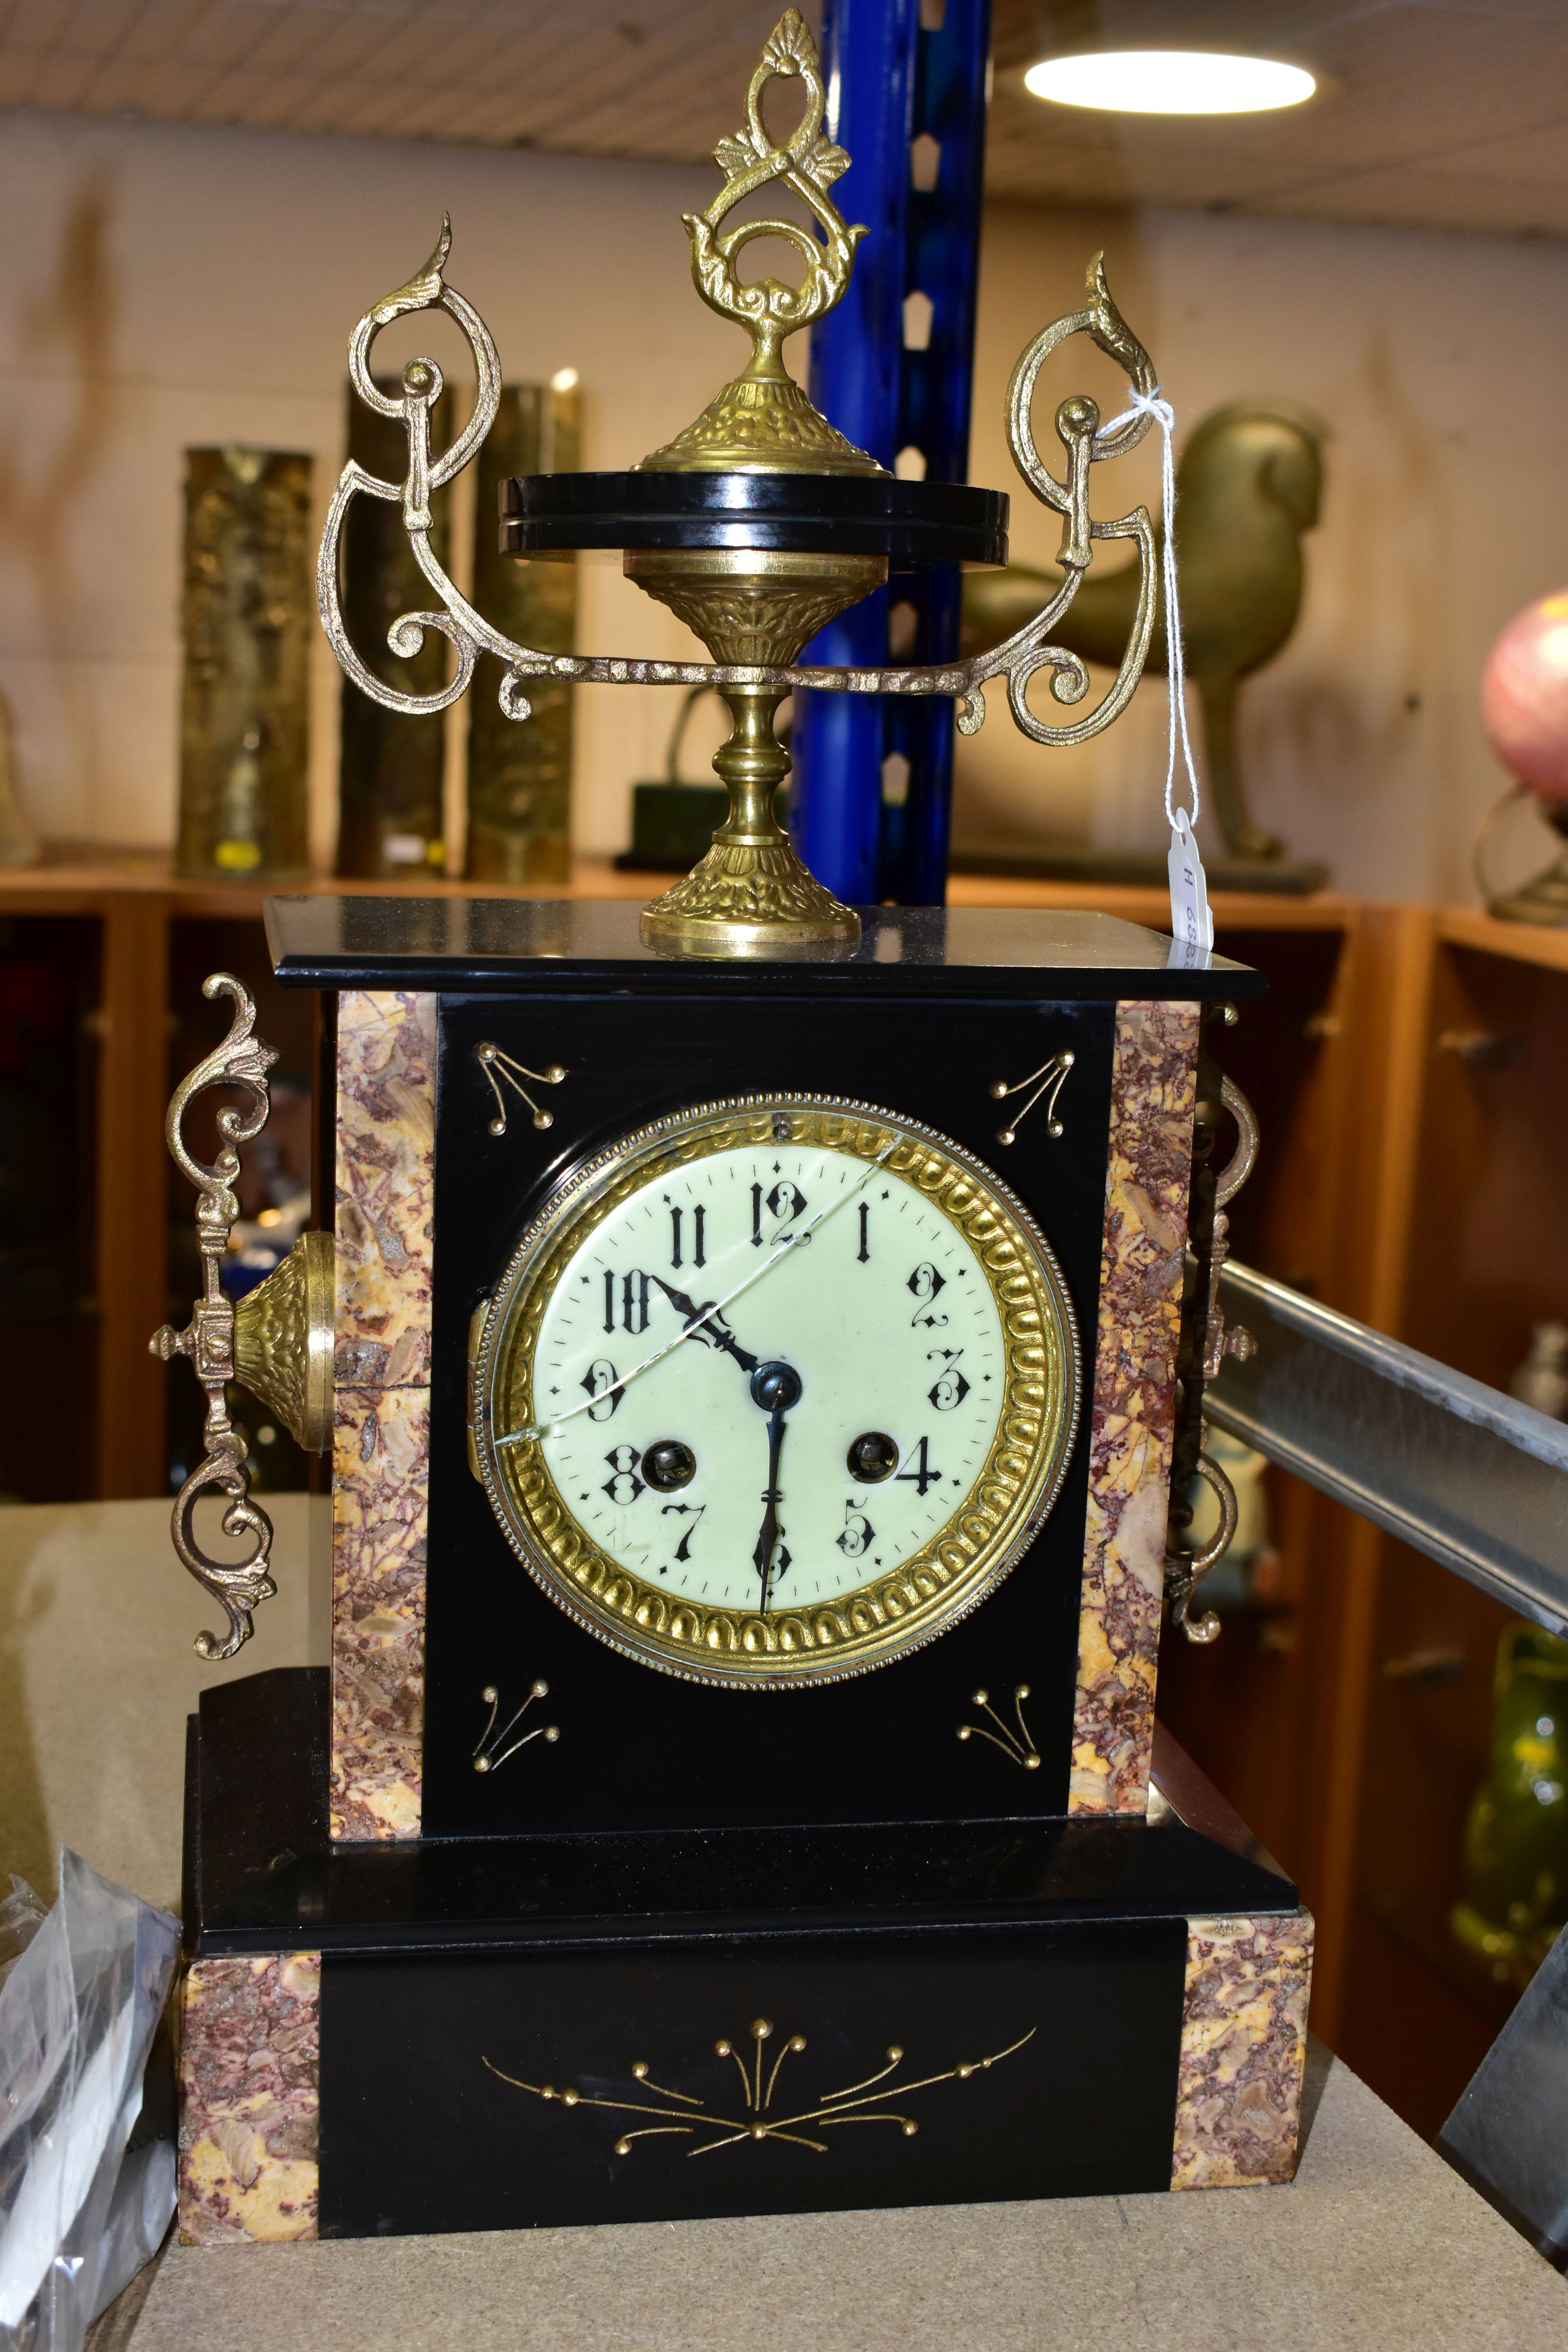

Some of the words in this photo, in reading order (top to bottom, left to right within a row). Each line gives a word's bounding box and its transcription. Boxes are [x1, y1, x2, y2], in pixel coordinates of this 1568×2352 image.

[670, 1204, 706, 1269] 11
[750, 1181, 811, 1248] 12
[857, 1201, 871, 1264] 1
[603, 1269, 652, 1334] 10
[906, 1262, 948, 1328] 2
[579, 1359, 626, 1423] 9
[927, 1349, 971, 1410] 3
[600, 1445, 646, 1505] 8
[892, 1436, 943, 1497] 4
[661, 1504, 706, 1563] 7
[752, 1523, 792, 1584] 6
[835, 1497, 876, 1558] 5
